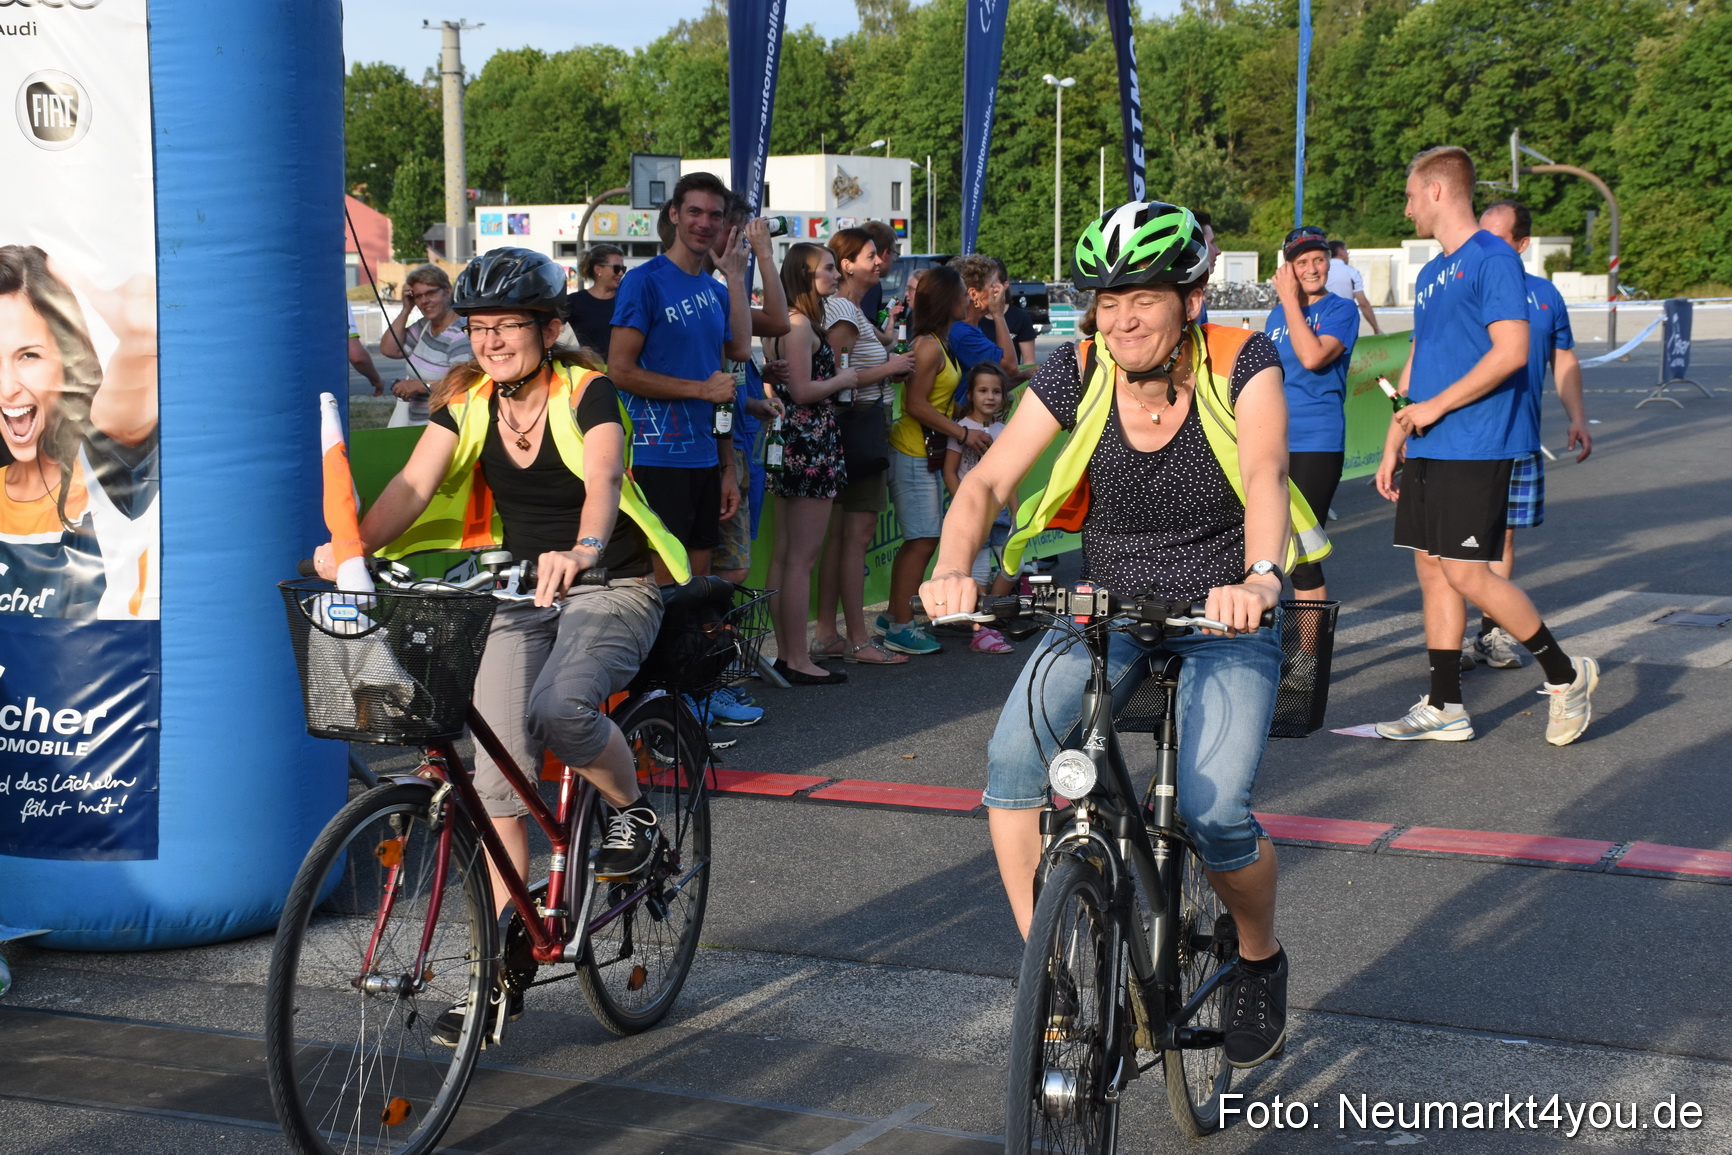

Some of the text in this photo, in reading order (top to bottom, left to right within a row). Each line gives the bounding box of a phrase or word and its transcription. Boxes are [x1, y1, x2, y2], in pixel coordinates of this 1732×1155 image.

[32, 93, 74, 128] FIAT
[15, 771, 48, 793] das
[51, 771, 137, 794] Lächeln
[20, 795, 129, 824] fährt mit!
